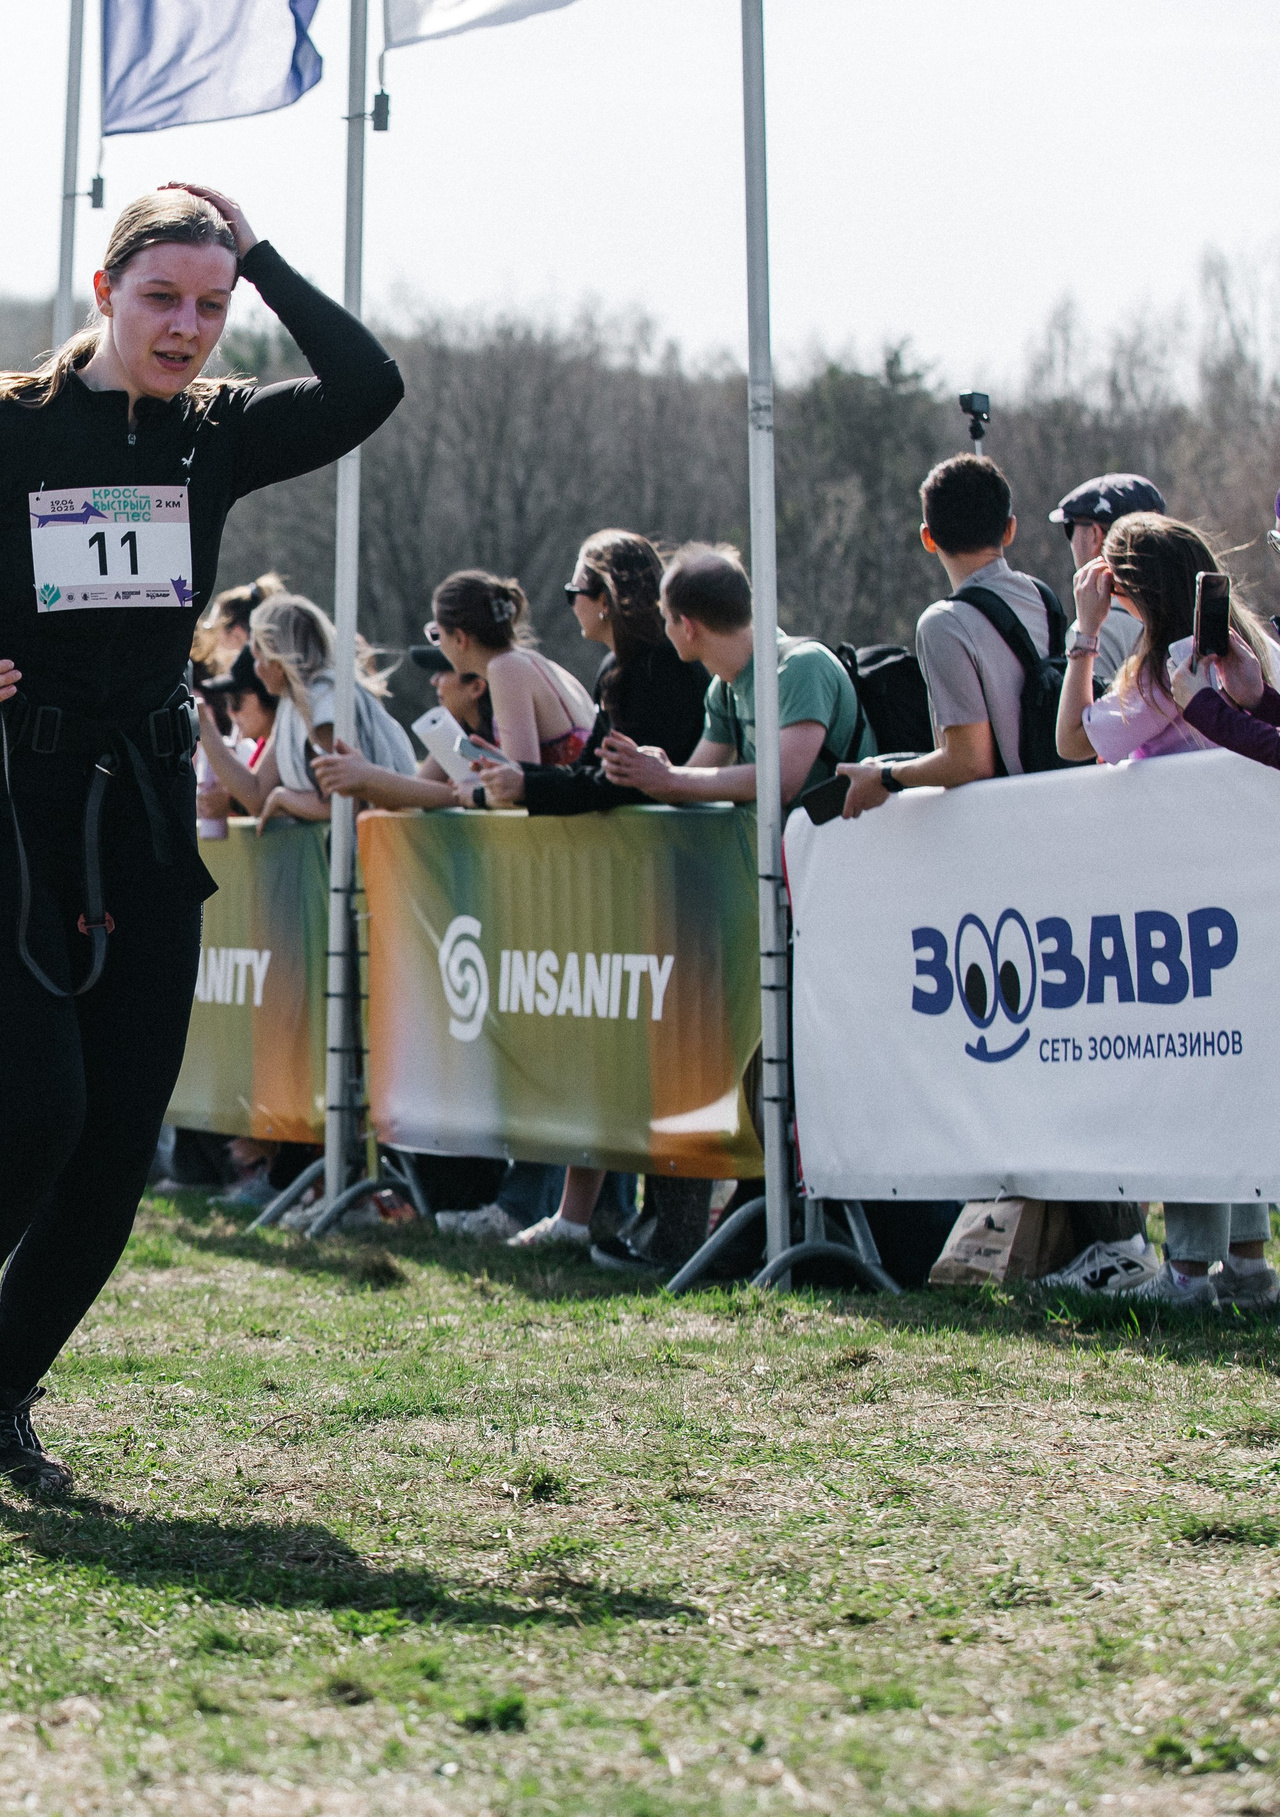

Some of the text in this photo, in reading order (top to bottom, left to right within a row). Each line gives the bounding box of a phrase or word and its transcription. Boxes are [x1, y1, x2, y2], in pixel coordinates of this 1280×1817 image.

[92, 488, 138, 499] КРОСС
[155, 499, 162, 508] 2
[88, 531, 138, 576] 11
[498, 949, 675, 1021] INSANITY
[1038, 1030, 1243, 1062] СЕТЬ ЗООМАГАЗИНОВ
